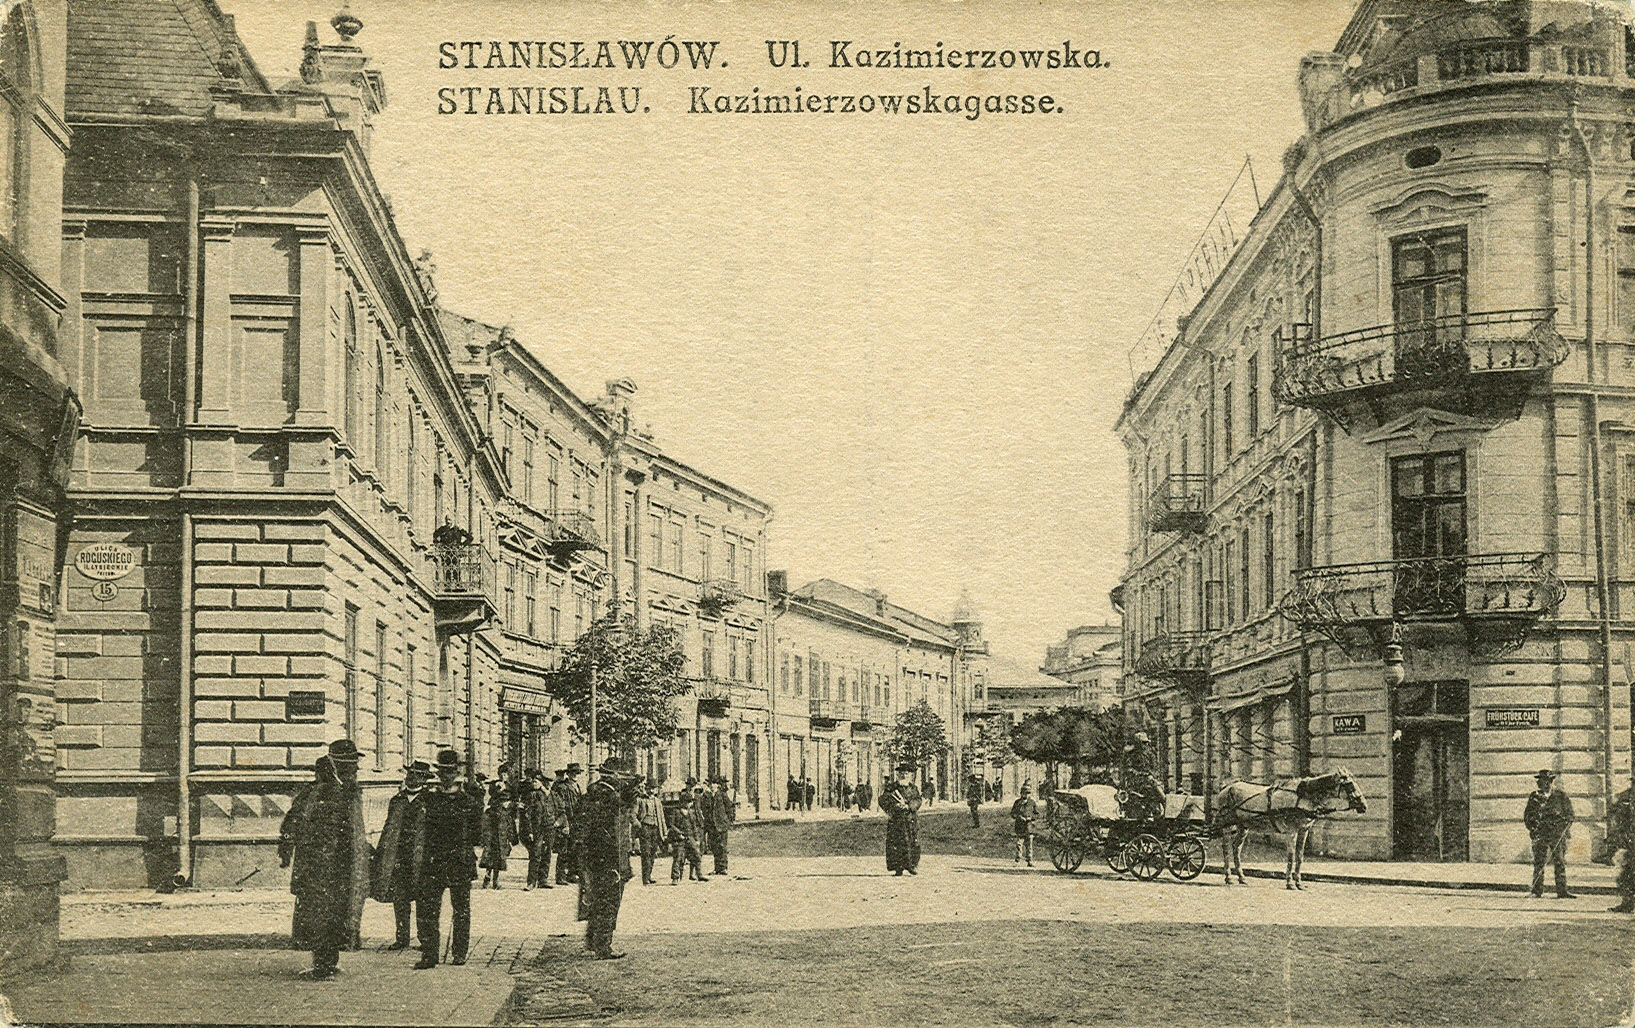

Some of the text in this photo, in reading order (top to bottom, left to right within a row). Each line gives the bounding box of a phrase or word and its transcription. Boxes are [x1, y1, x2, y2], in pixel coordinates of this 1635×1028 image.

[80, 552, 132, 564] ROGUSKIEGO
[100, 583, 112, 595] 15
[1334, 717, 1361, 728] KAWA
